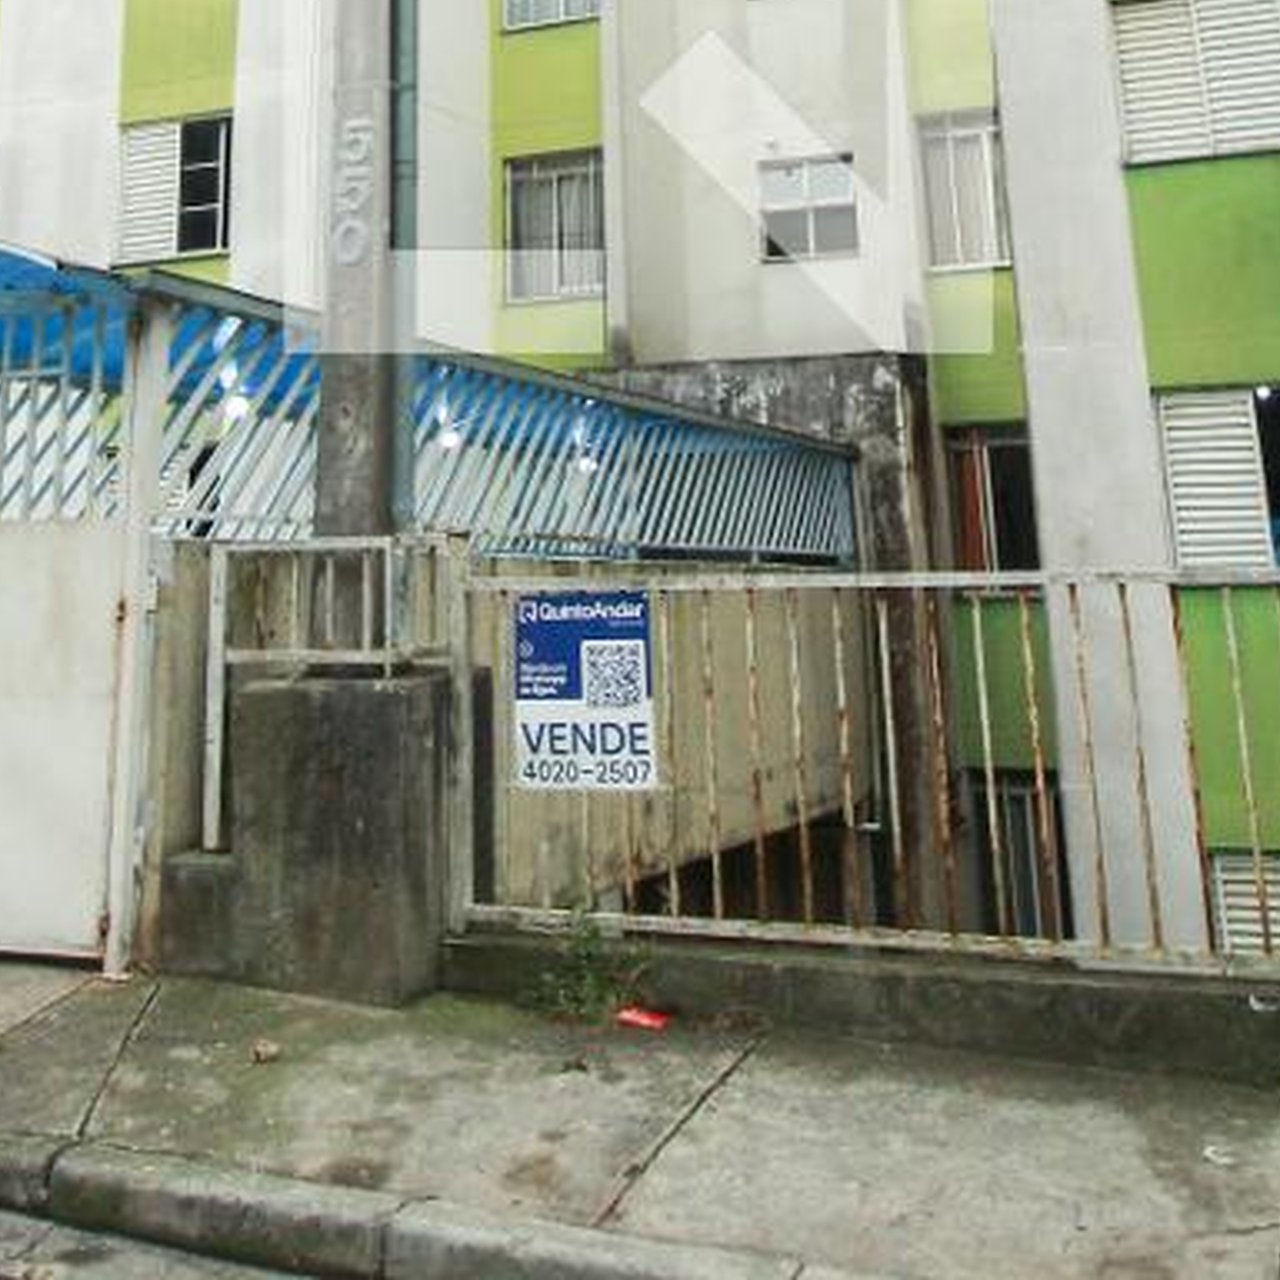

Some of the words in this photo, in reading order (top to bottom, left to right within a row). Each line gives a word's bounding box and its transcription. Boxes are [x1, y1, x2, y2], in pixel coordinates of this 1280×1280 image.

[539, 602, 644, 620] QuintoAndar
[521, 722, 650, 755] VENDE
[522, 760, 652, 785] 4020-2507
